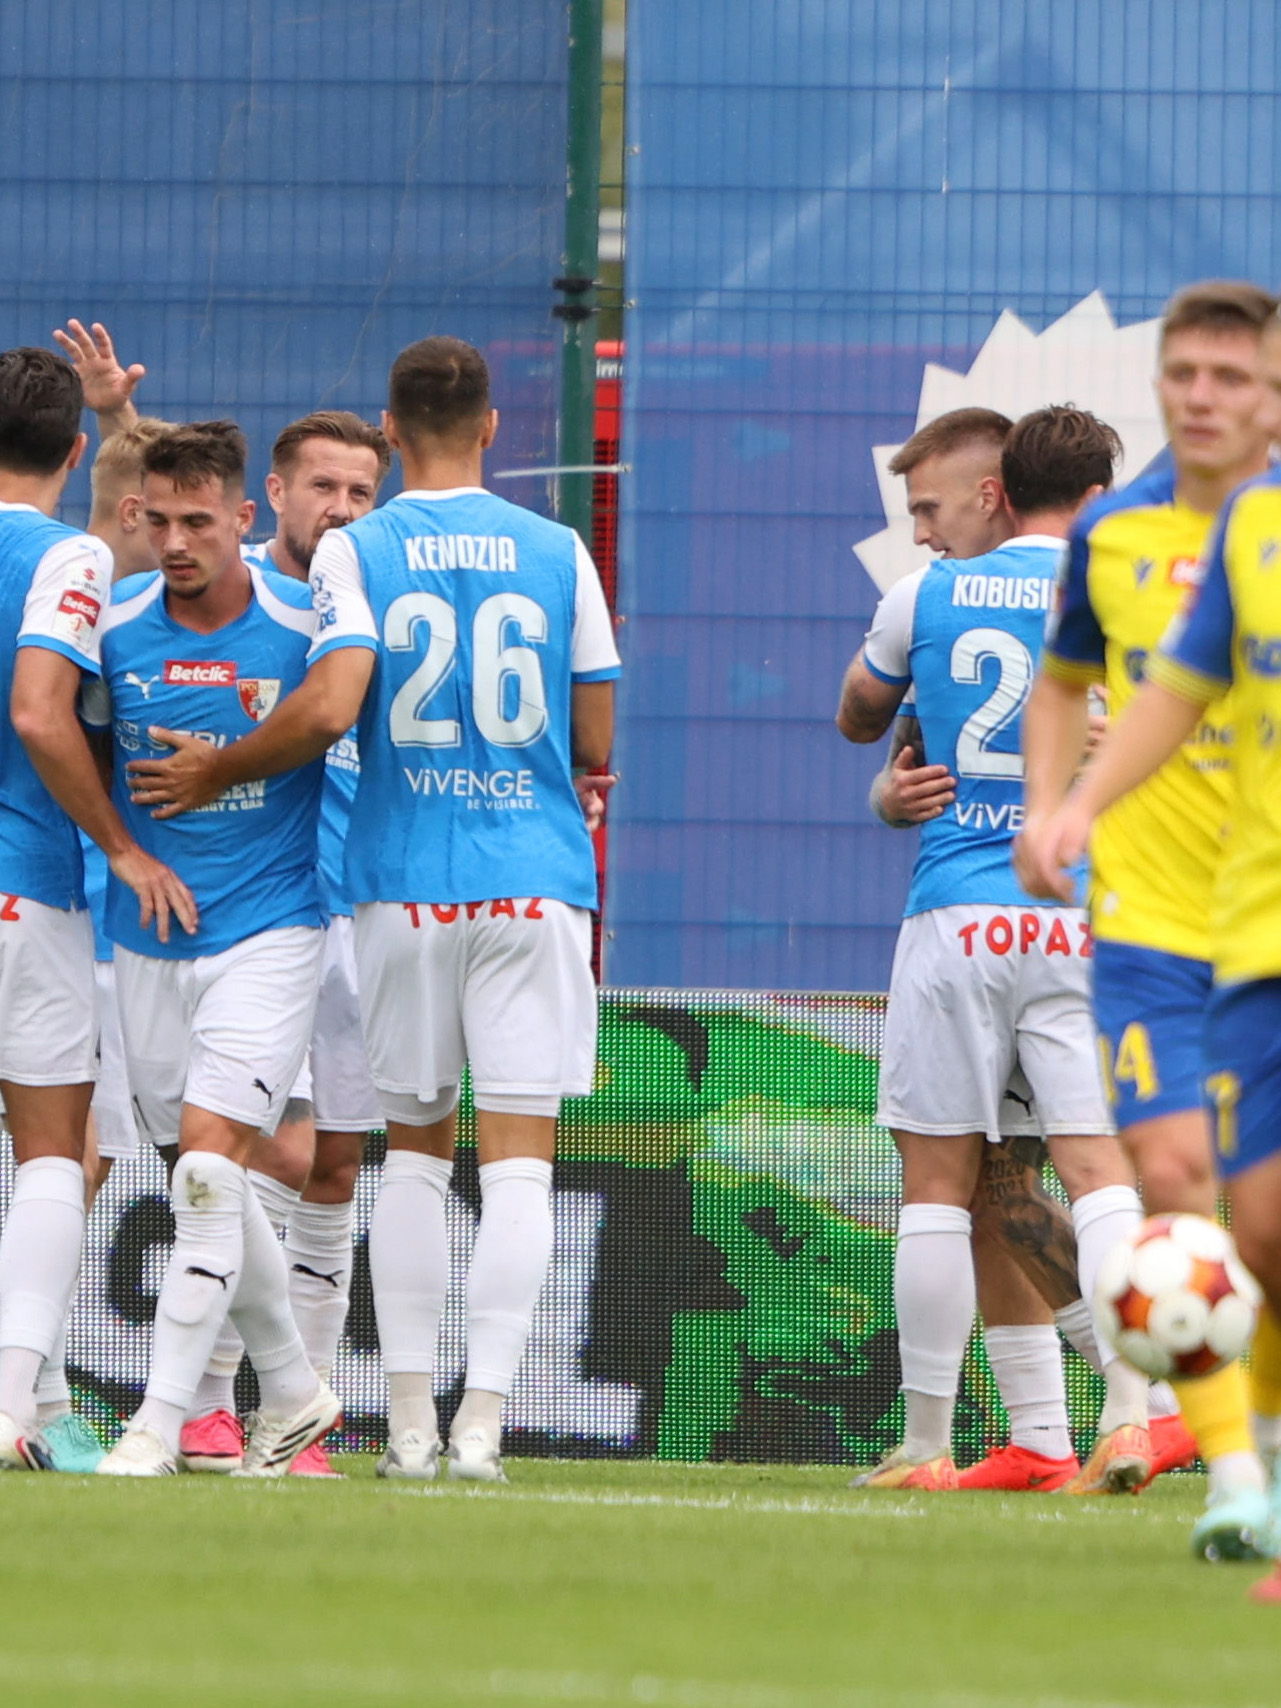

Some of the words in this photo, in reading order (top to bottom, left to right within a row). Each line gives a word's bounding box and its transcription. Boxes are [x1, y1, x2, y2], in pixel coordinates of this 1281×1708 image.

[405, 535, 517, 572] KENDZIA
[169, 664, 230, 682] Betclic
[384, 592, 547, 748] 26
[951, 628, 1033, 781] 2
[958, 913, 1094, 958] TOPAZ
